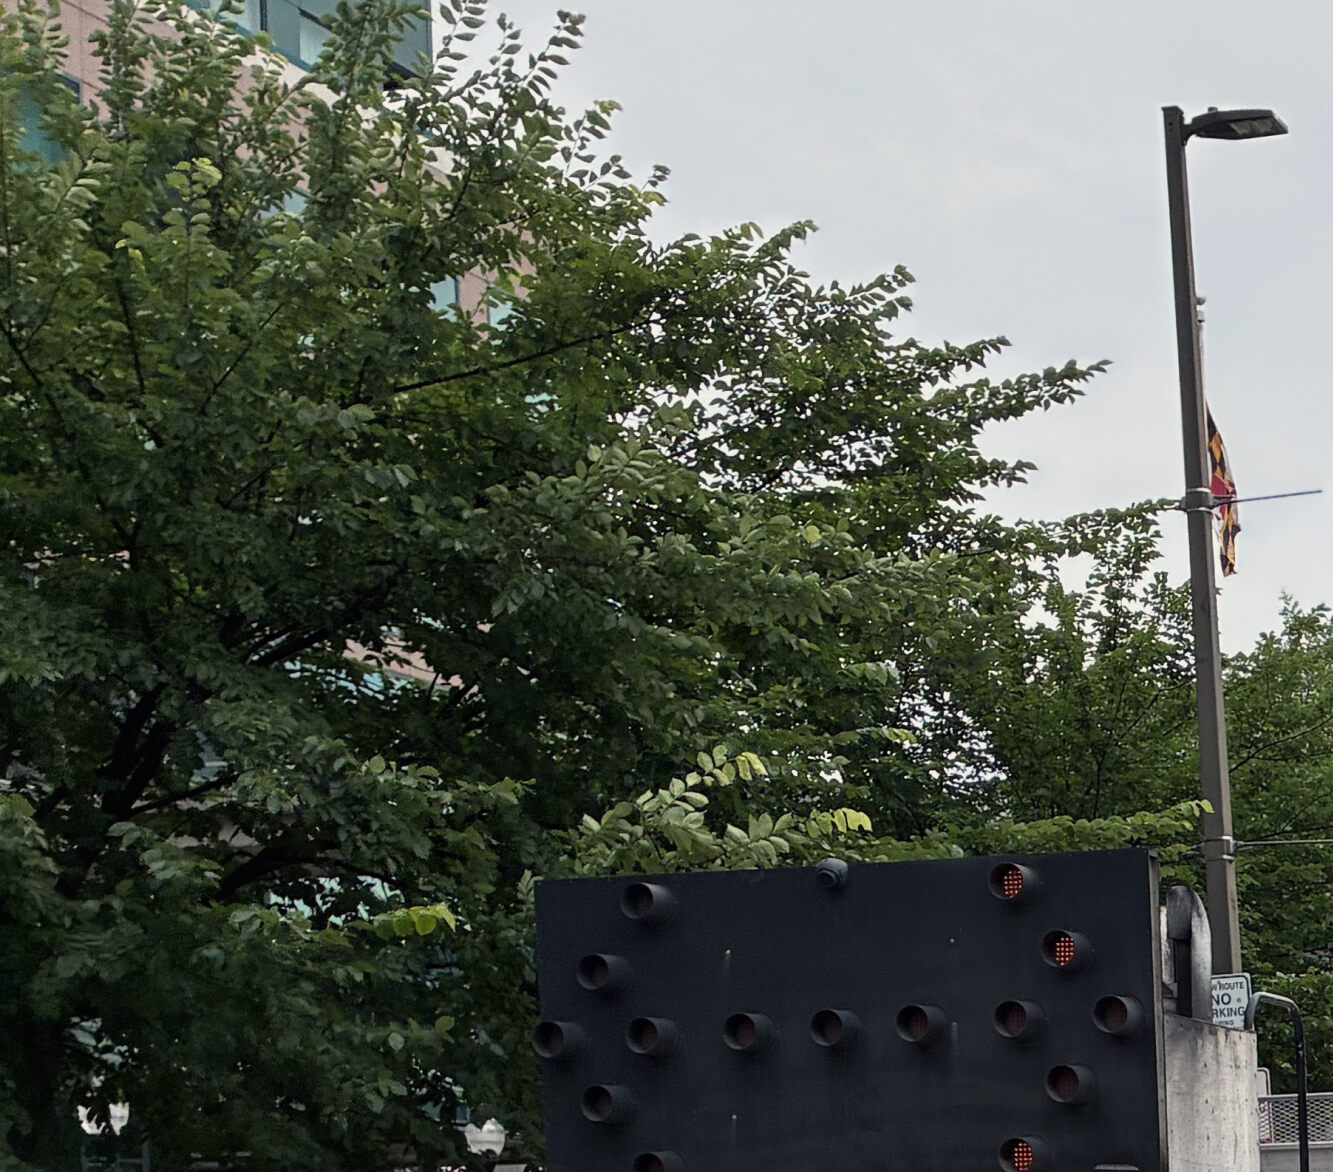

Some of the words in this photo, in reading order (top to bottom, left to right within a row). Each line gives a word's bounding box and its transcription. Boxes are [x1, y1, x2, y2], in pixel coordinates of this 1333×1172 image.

[1219, 981, 1245, 991] ROUTE
[1211, 992, 1232, 1006] NO
[1211, 1006, 1246, 1018] RKING
